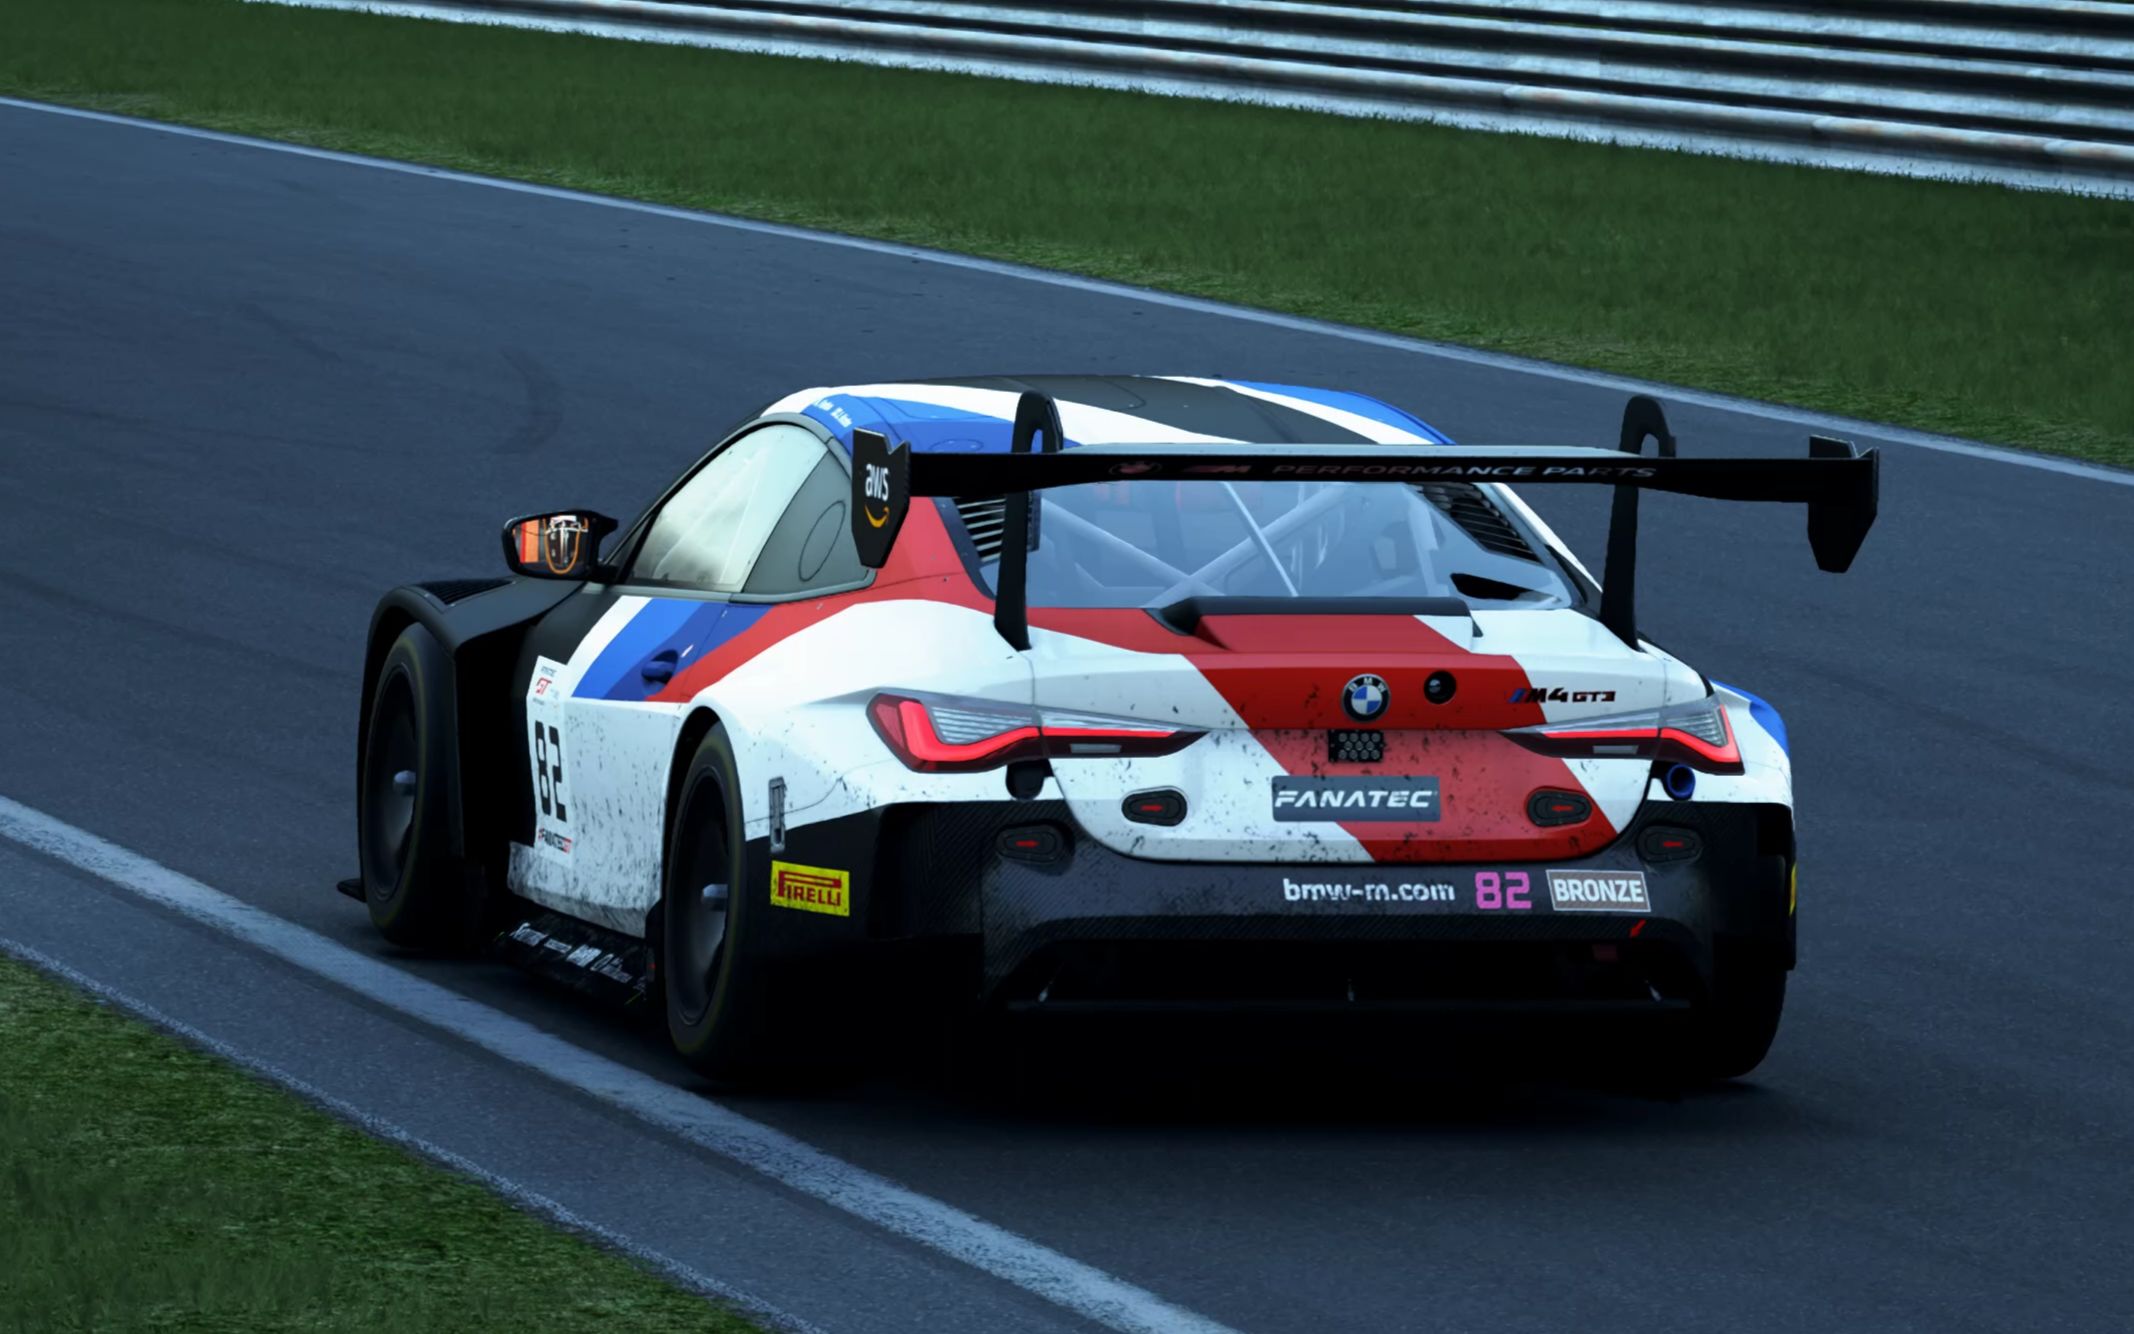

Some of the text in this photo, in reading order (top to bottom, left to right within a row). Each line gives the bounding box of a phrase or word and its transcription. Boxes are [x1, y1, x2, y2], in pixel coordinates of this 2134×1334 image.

[865, 463, 889, 502] aws
[1272, 465, 1536, 476] PERFORMANCE
[1542, 466, 1657, 477] PARTS
[1572, 691, 1616, 703] GT3
[535, 720, 567, 823] 82
[1275, 790, 1433, 808] FANATEC
[778, 869, 842, 907] PIRELLI
[1283, 871, 1644, 909] bmw-m.com 82 BRONZE
